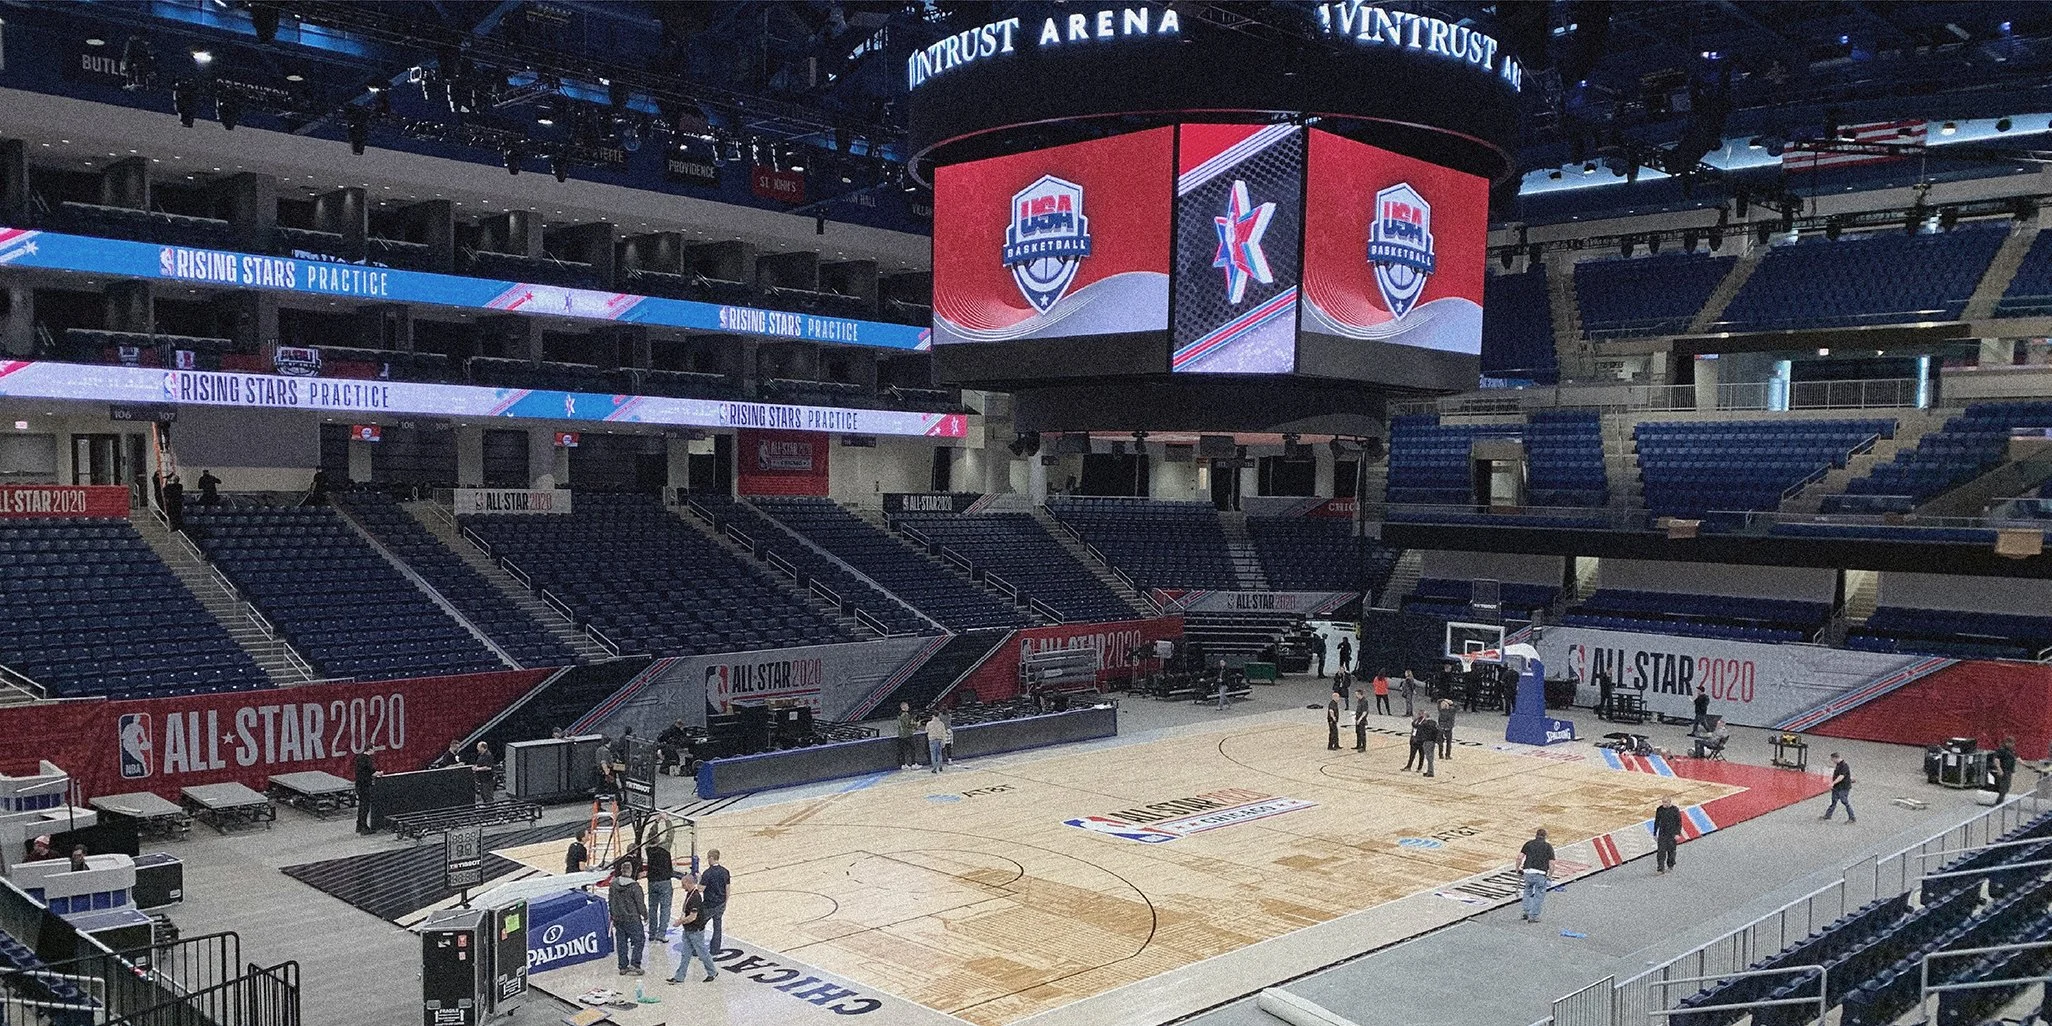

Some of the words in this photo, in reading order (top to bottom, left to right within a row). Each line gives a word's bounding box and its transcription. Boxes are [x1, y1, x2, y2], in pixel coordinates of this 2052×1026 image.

[1039, 7, 1179, 45] ARENA
[668, 159, 715, 179] PROVIDENCE
[1020, 195, 1075, 237] USA
[1383, 201, 1424, 248] USA
[1007, 239, 1086, 258] BASKETBALL
[1371, 245, 1432, 266] BASKETBALL
[177, 250, 237, 282] RISING
[243, 256, 296, 288] STARS
[307, 265, 388, 296] PRACTICE
[729, 307, 766, 333] RISING
[768, 312, 802, 336] STARS
[807, 318, 859, 341] PRACTICE
[181, 373, 239, 401] RISING
[245, 377, 298, 405] STARS
[310, 381, 389, 408] PRACTICE
[114, 410, 132, 419] 106
[158, 411, 176, 420] 107
[729, 404, 766, 426] RISING
[768, 406, 802, 428] STARS
[807, 410, 859, 431] PRACTICE
[53, 490, 86, 513] 2020
[529, 492, 553, 511] 2020
[1275, 595, 1297, 610] 2020
[791, 658, 822, 687] 2020
[1698, 656, 1755, 702] 2020
[329, 693, 405, 758] 2020
[1545, 727, 1571, 743] SPALDING
[962, 783, 1016, 798] AT&T
[1200, 805, 1278, 825] CHICAGO
[1431, 825, 1484, 843] AT&T
[526, 931, 599, 970] PALDING
